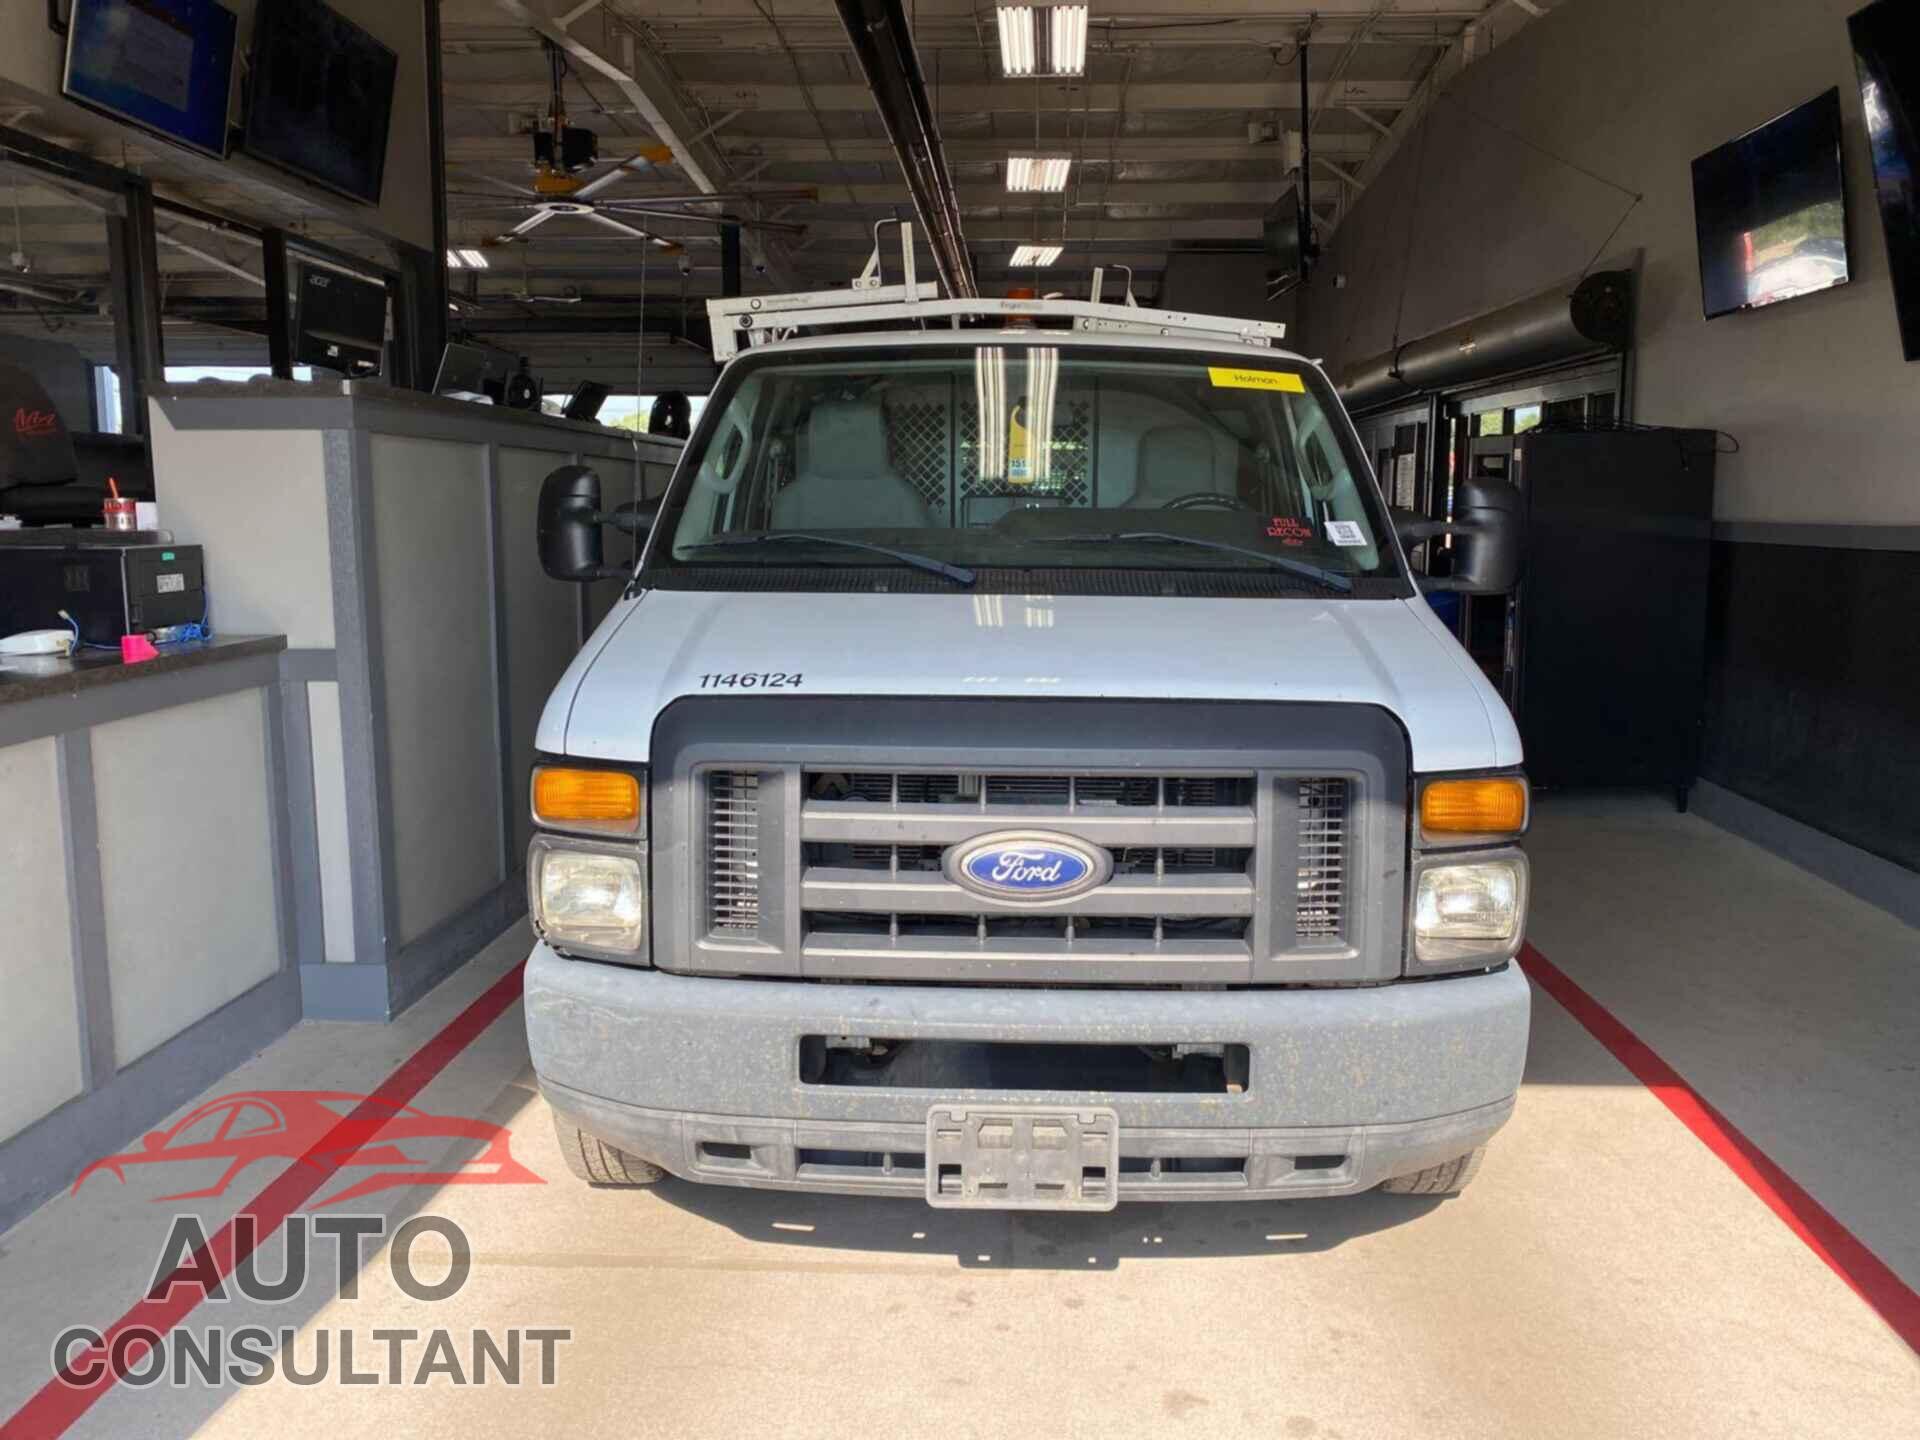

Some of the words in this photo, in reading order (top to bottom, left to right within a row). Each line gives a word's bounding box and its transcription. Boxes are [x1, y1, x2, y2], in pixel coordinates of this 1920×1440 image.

[1233, 374, 1278, 385] Holman
[1272, 517, 1299, 528] FULL
[700, 672, 803, 688] 1146124
[992, 852, 1062, 881] Ford
